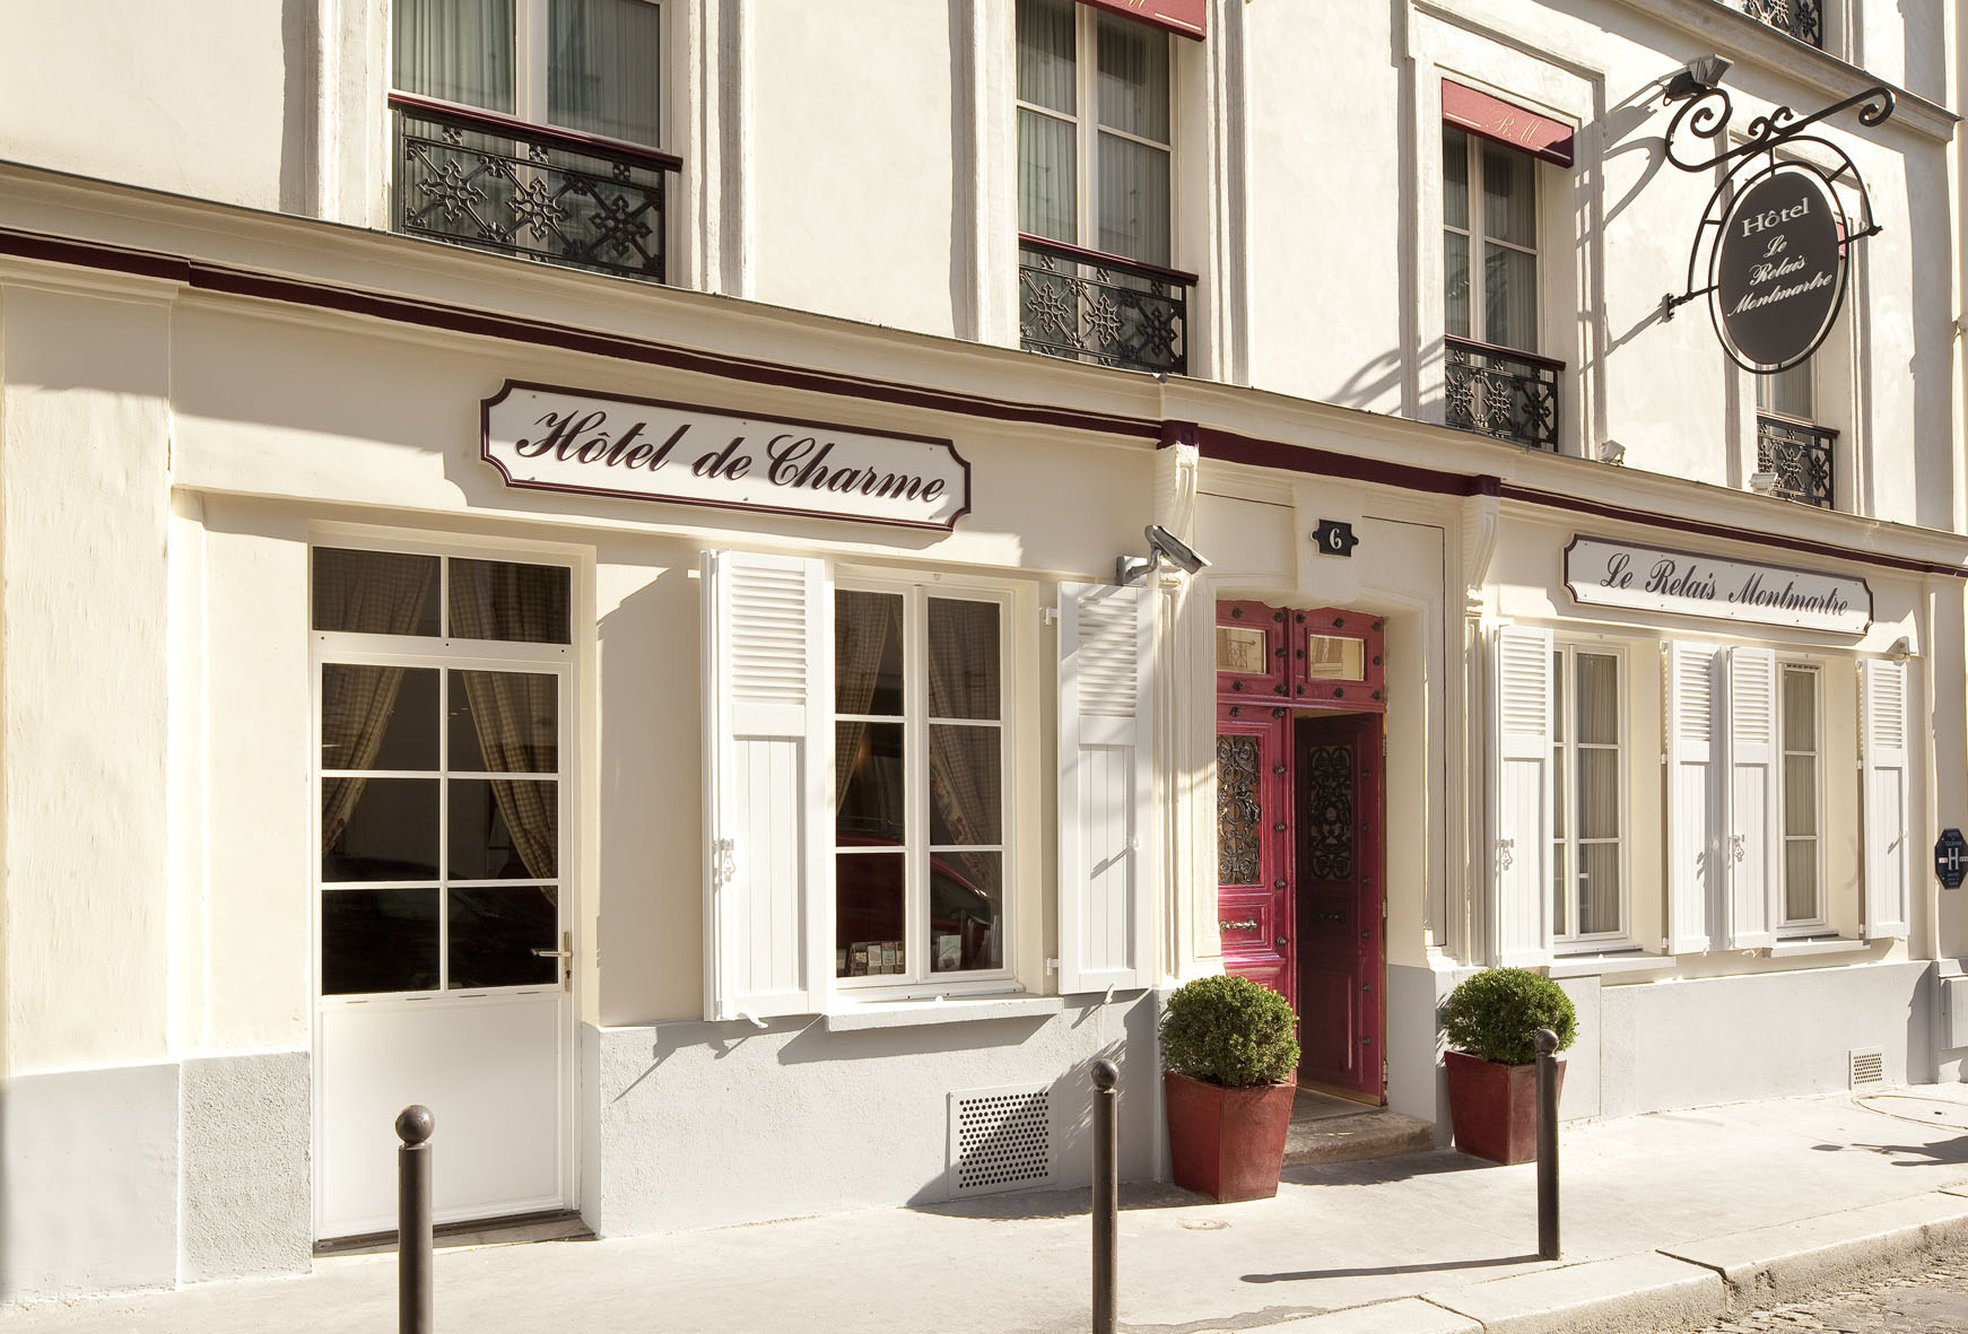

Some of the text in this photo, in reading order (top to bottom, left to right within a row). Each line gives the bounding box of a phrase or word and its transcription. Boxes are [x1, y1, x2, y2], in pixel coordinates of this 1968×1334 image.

[1741, 196, 1811, 237] Hôtel
[1763, 234, 1788, 259] Le
[1749, 255, 1806, 286] Relais
[1726, 271, 1833, 317] Montmartre
[514, 409, 946, 503] Hôtel de Charme
[1329, 527, 1343, 550] 6
[1600, 552, 1849, 617] Le Relais Montmartre
[1948, 847, 1959, 871] H
